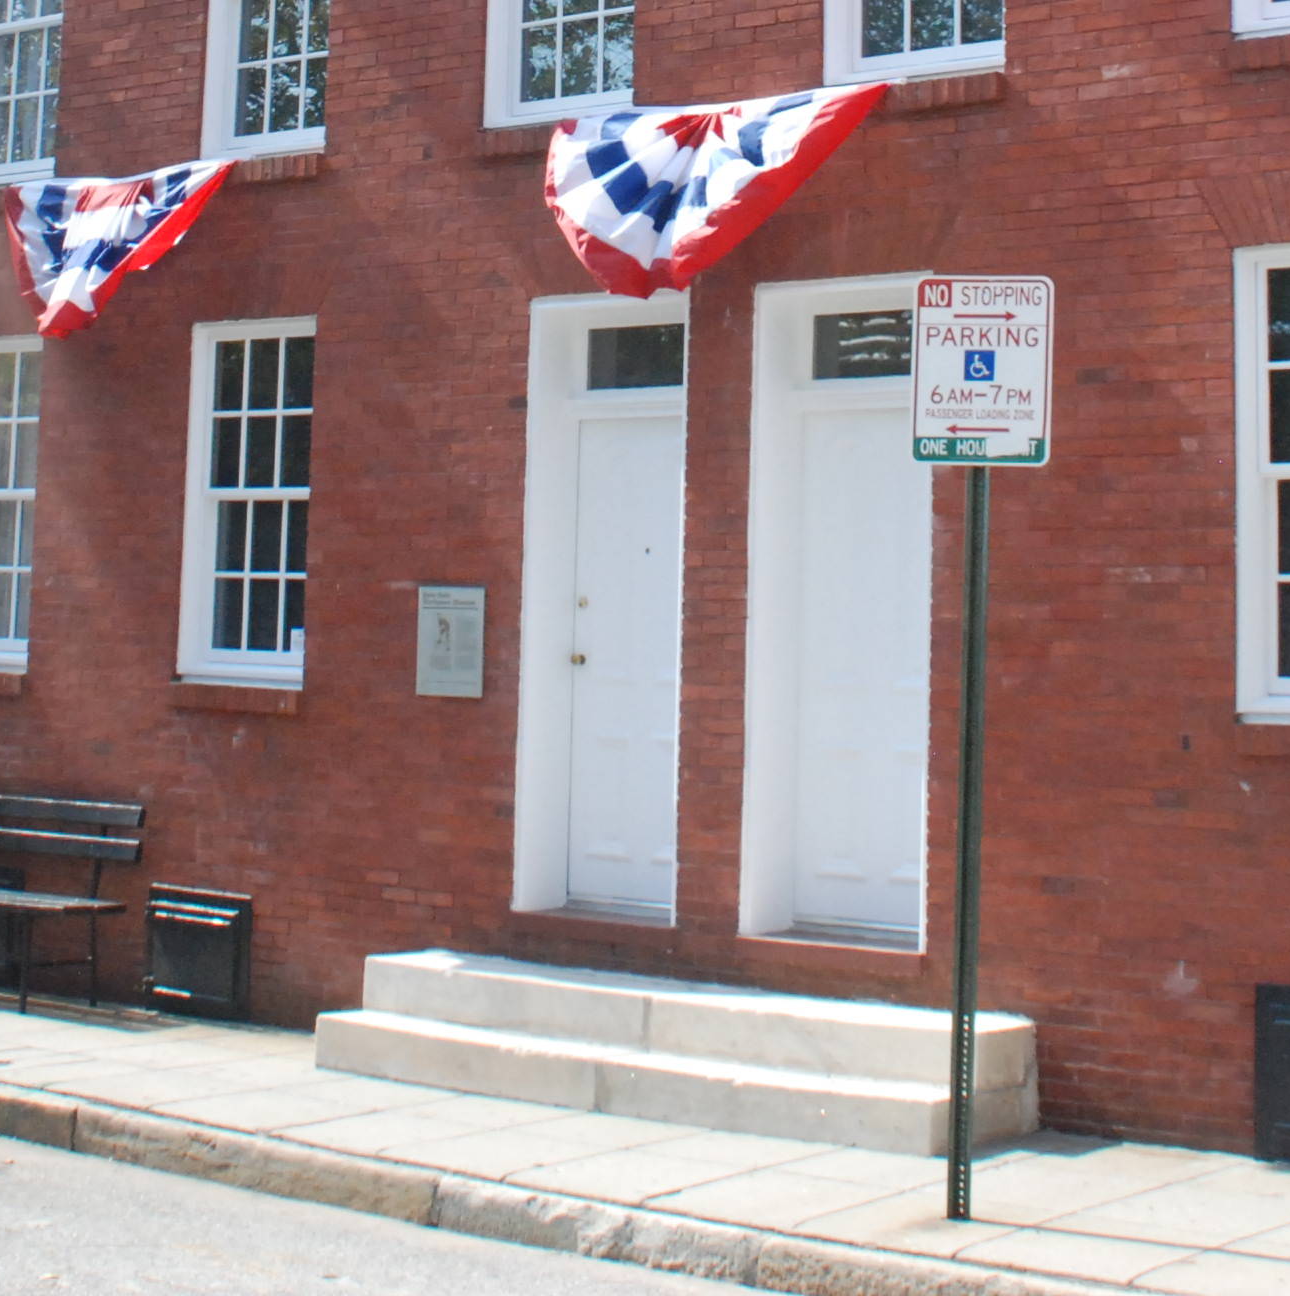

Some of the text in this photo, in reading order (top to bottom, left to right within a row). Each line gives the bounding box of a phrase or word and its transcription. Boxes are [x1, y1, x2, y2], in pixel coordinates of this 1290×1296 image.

[924, 284, 1042, 307] NO STOPPING
[926, 326, 1039, 348] PARKING
[925, 408, 1034, 421] PASSENGER LOADING ZONE
[920, 439, 987, 456] ONE HOU
